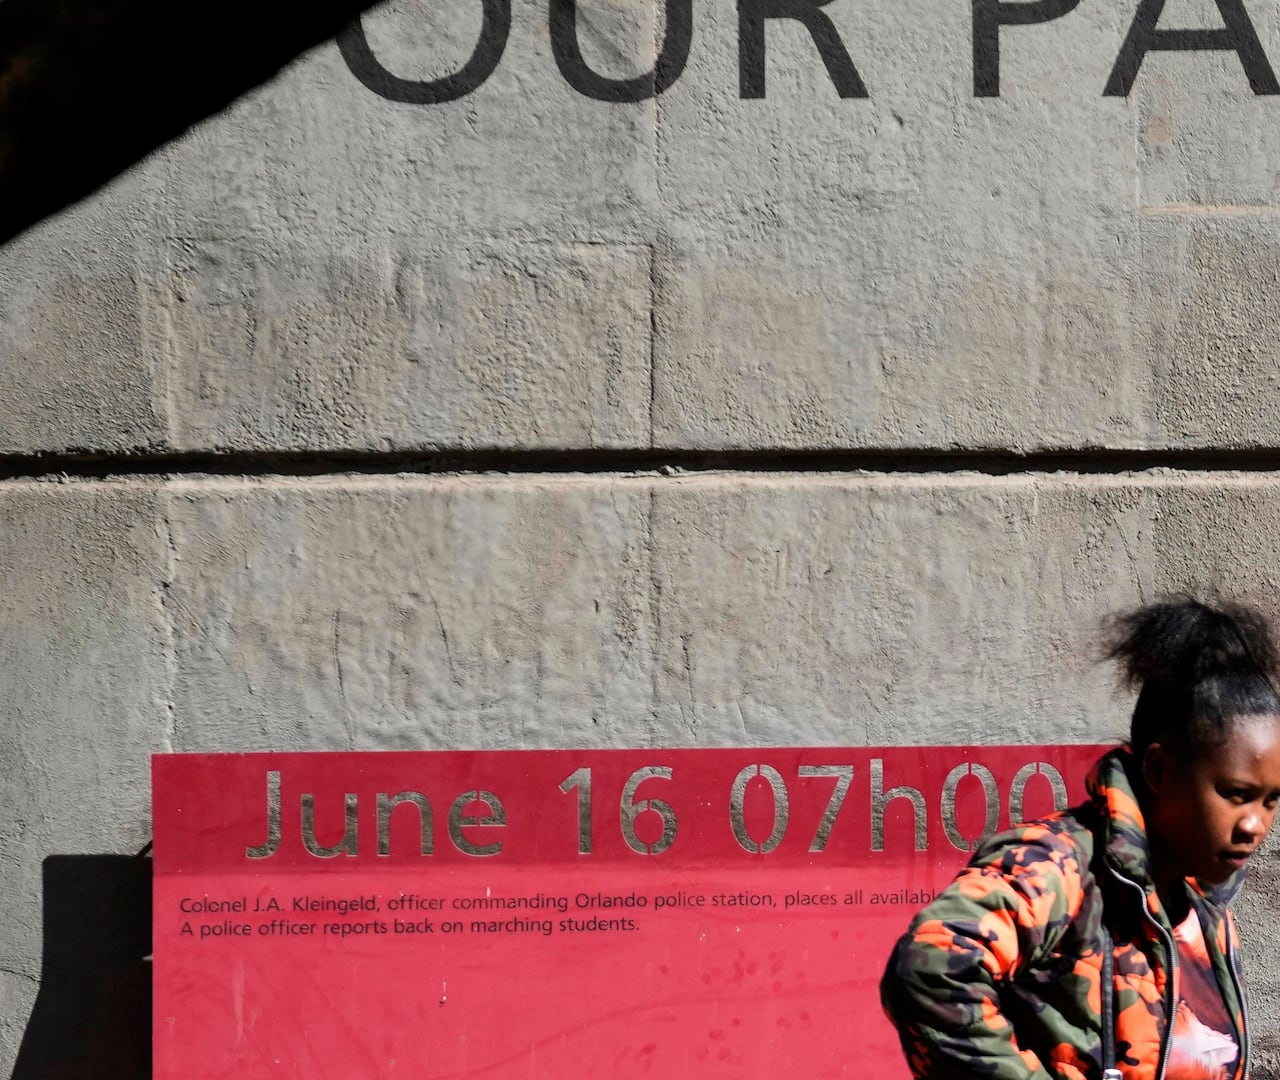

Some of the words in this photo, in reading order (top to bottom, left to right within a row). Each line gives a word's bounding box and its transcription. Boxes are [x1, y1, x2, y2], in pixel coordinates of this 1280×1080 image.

[245, 770, 506, 859] June
[557, 766, 678, 856] 16
[729, 758, 1069, 854] 07h00
[180, 896, 246, 914] Colonel
[252, 897, 285, 913] J.A.
[292, 894, 380, 915] Kleingeld,
[387, 894, 446, 911] officer
[451, 892, 568, 913] commanding
[574, 891, 648, 909] Orlando
[654, 890, 706, 911] police
[711, 890, 777, 909] station,
[784, 889, 838, 909] places
[843, 888, 863, 905] all
[179, 921, 194, 937] A
[200, 920, 252, 940] police
[257, 919, 317, 936] officer
[323, 919, 388, 938] reports
[393, 917, 435, 935] back
[440, 920, 464, 934] on
[470, 916, 553, 937] marching
[559, 914, 640, 933] students.
